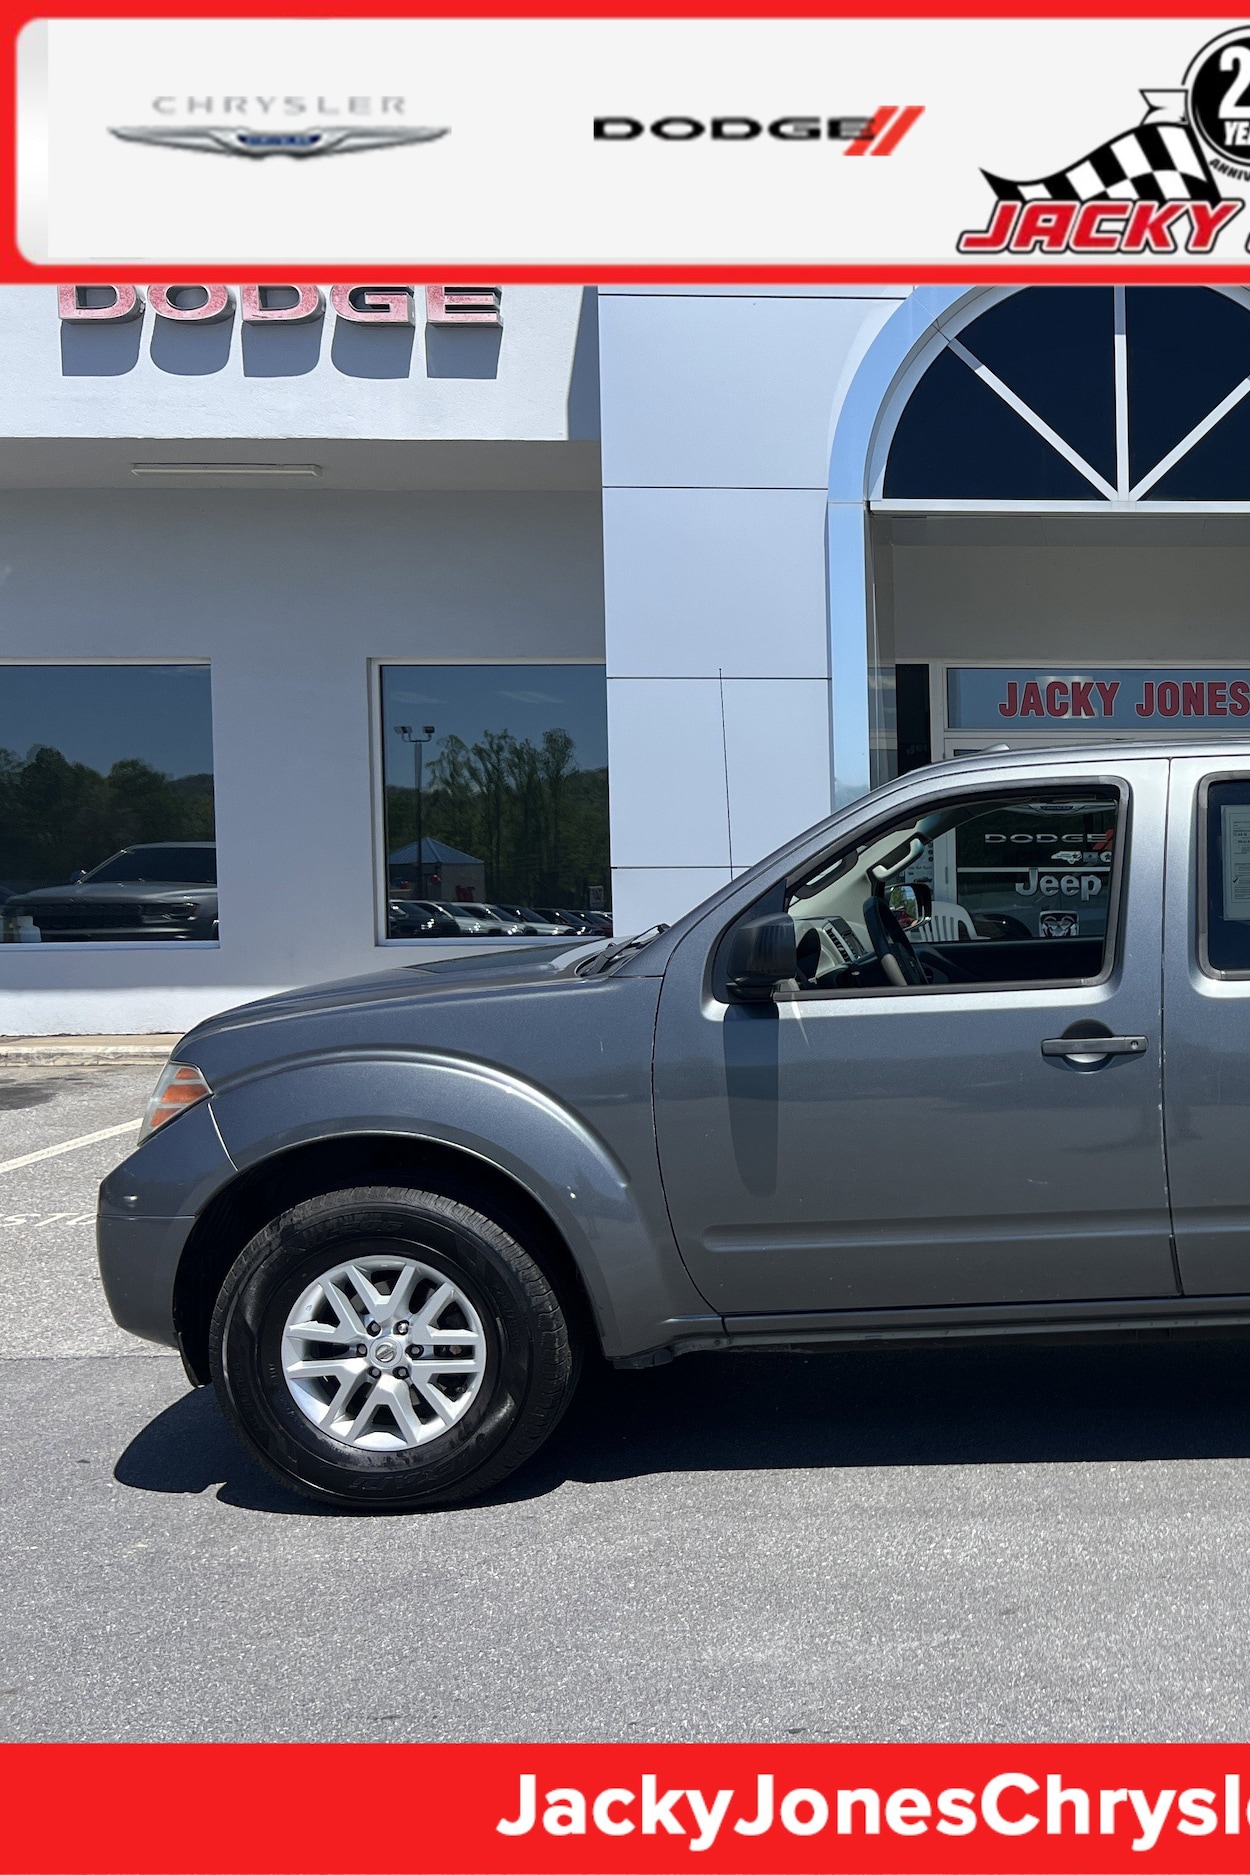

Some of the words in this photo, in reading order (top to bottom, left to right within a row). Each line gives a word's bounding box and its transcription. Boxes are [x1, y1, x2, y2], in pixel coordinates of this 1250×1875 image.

[998, 681, 1120, 718] JACKY
[1135, 681, 1250, 718] JONES
[984, 833, 1107, 844] DODGE
[1015, 867, 1102, 901] Jeep
